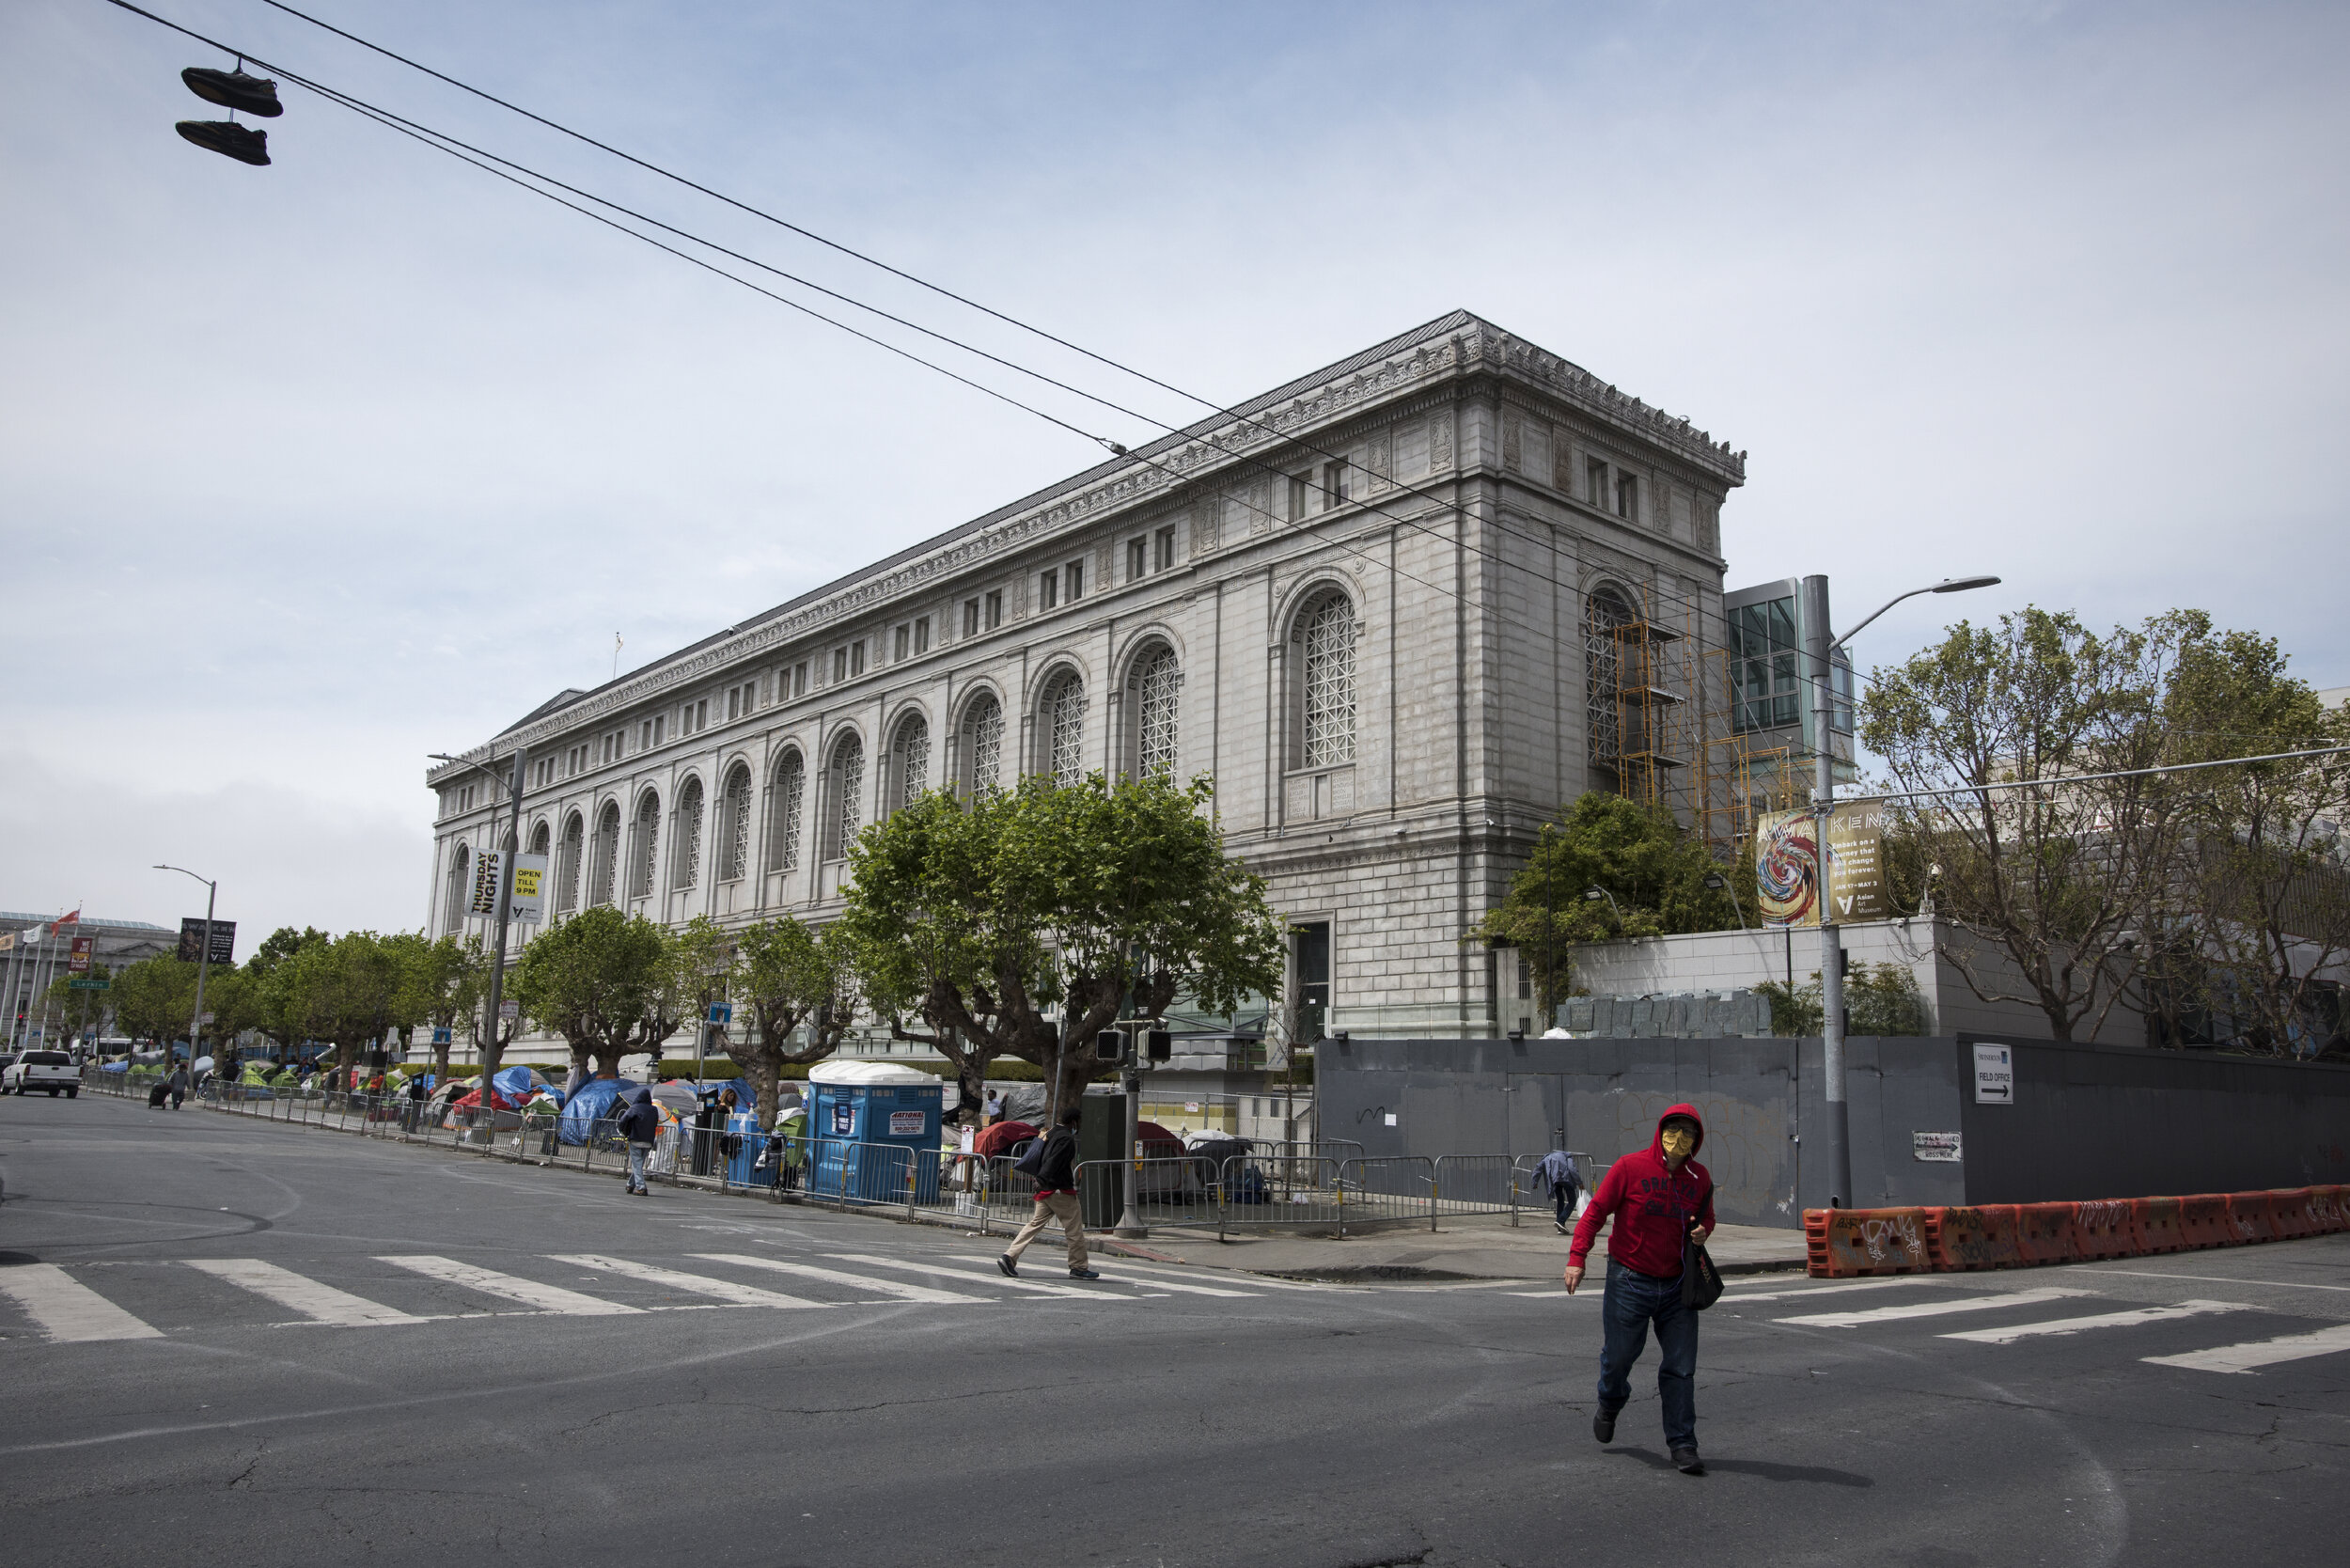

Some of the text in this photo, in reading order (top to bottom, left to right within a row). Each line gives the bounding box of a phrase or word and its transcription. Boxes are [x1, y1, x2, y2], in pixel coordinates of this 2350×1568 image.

[1832, 840, 1857, 849] Embark
[1832, 850, 1857, 860] journey
[1834, 859, 1846, 868] will
[518, 870, 540, 878] OPEN
[1848, 867, 1876, 875] forever.
[471, 852, 487, 914] THURSDAY
[481, 853, 499, 915] NIGHTS
[1979, 1072, 2011, 1082] FIELD OFFICE
